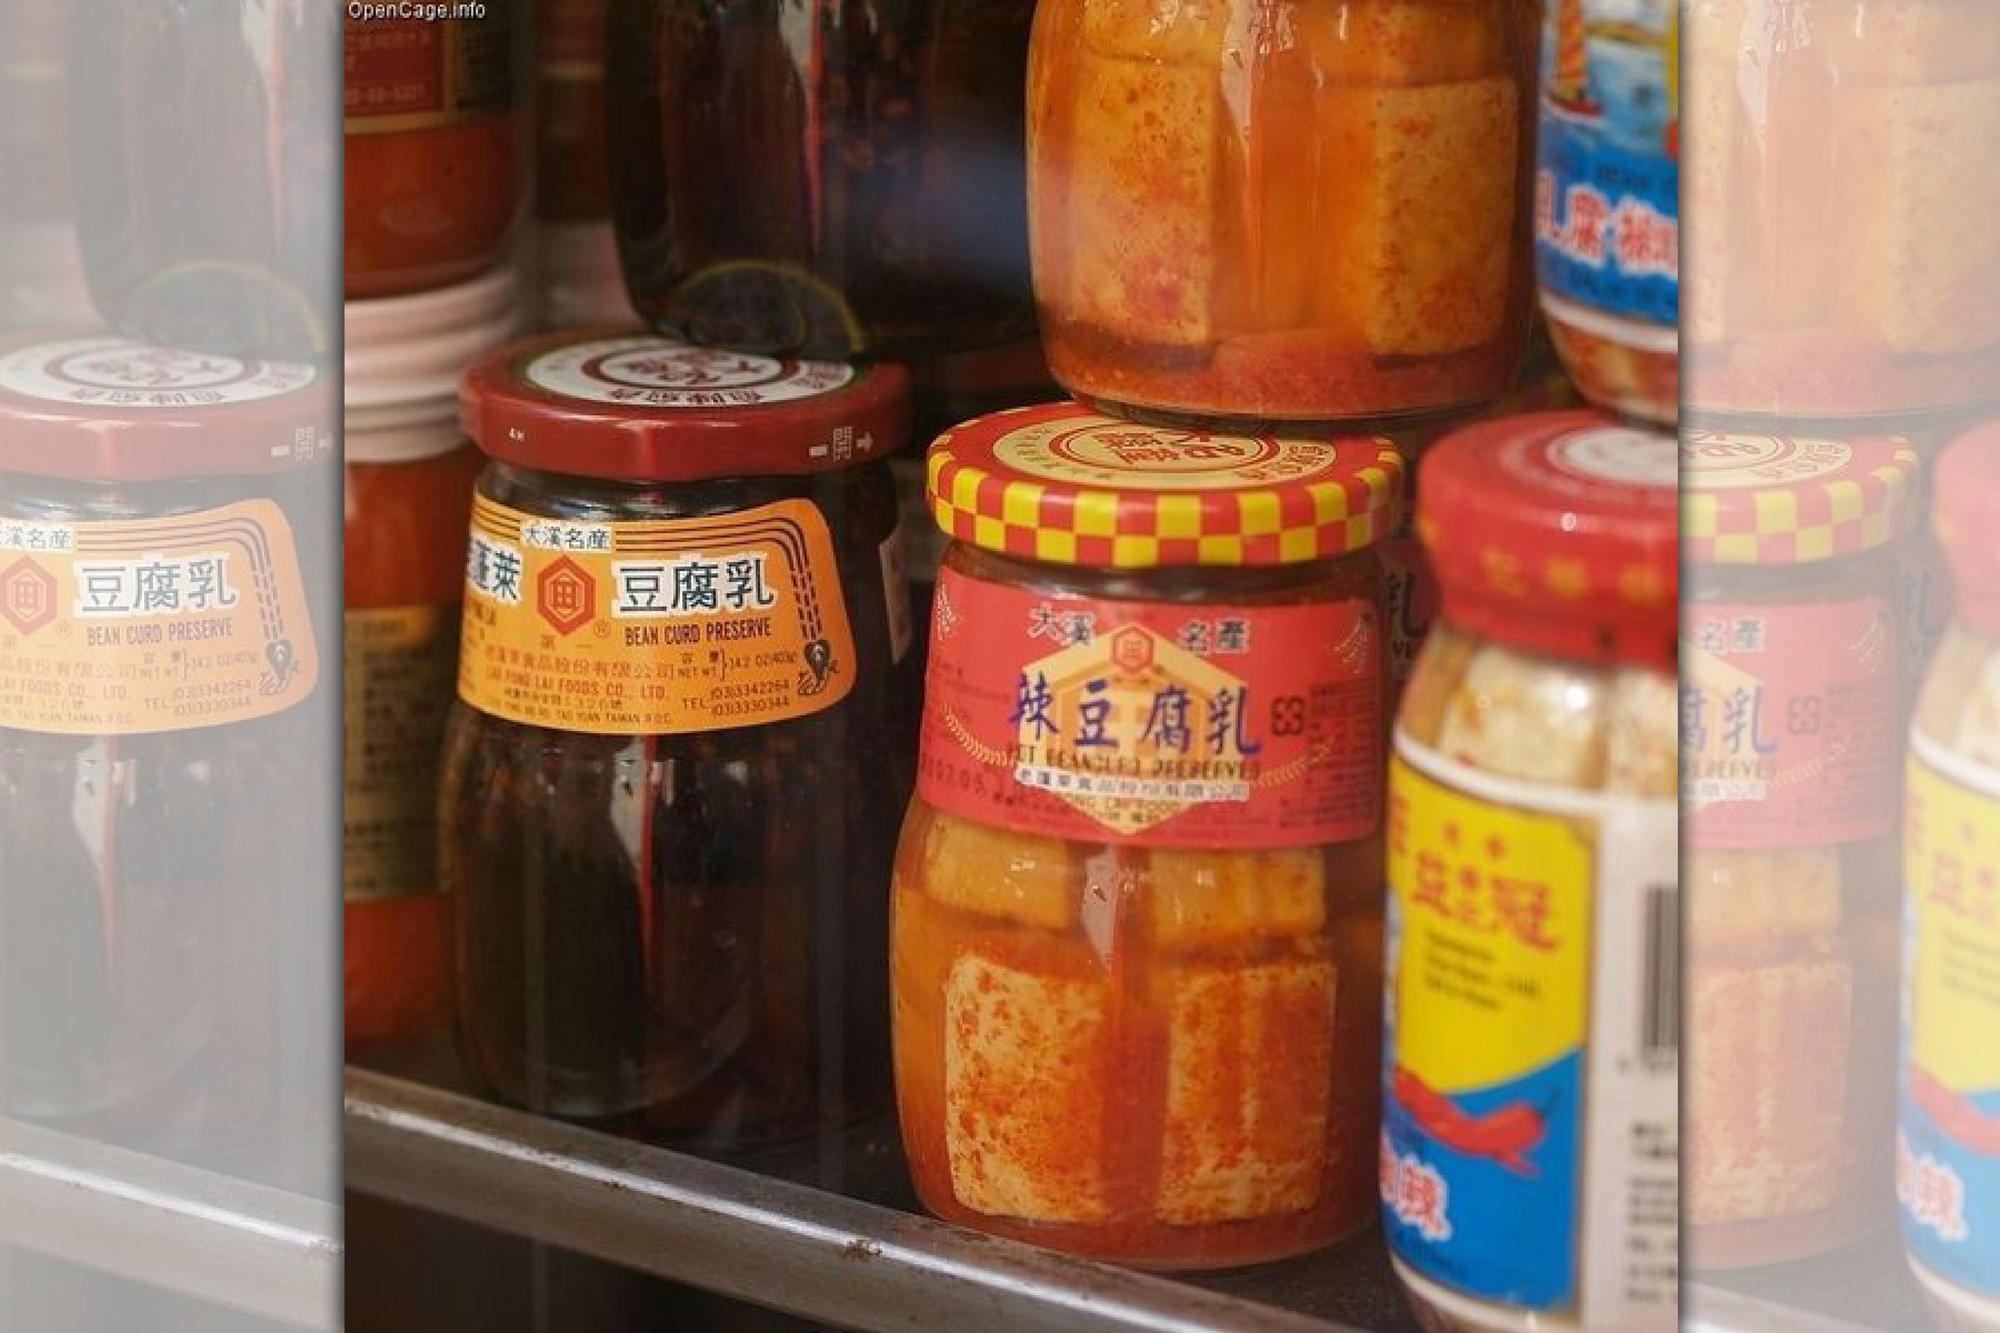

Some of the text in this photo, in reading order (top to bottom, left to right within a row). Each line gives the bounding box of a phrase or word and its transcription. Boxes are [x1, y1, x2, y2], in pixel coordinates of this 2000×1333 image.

[82, 558, 235, 611] 豆腐乳
[620, 558, 773, 611] 豆腐乳
[88, 618, 234, 646] BEAN CURD PRESERVE
[626, 618, 772, 646] BEAN CURD PRESERVE
[559, 679, 599, 697] FOODS
[1009, 673, 1261, 754] 辣豆腐乳
